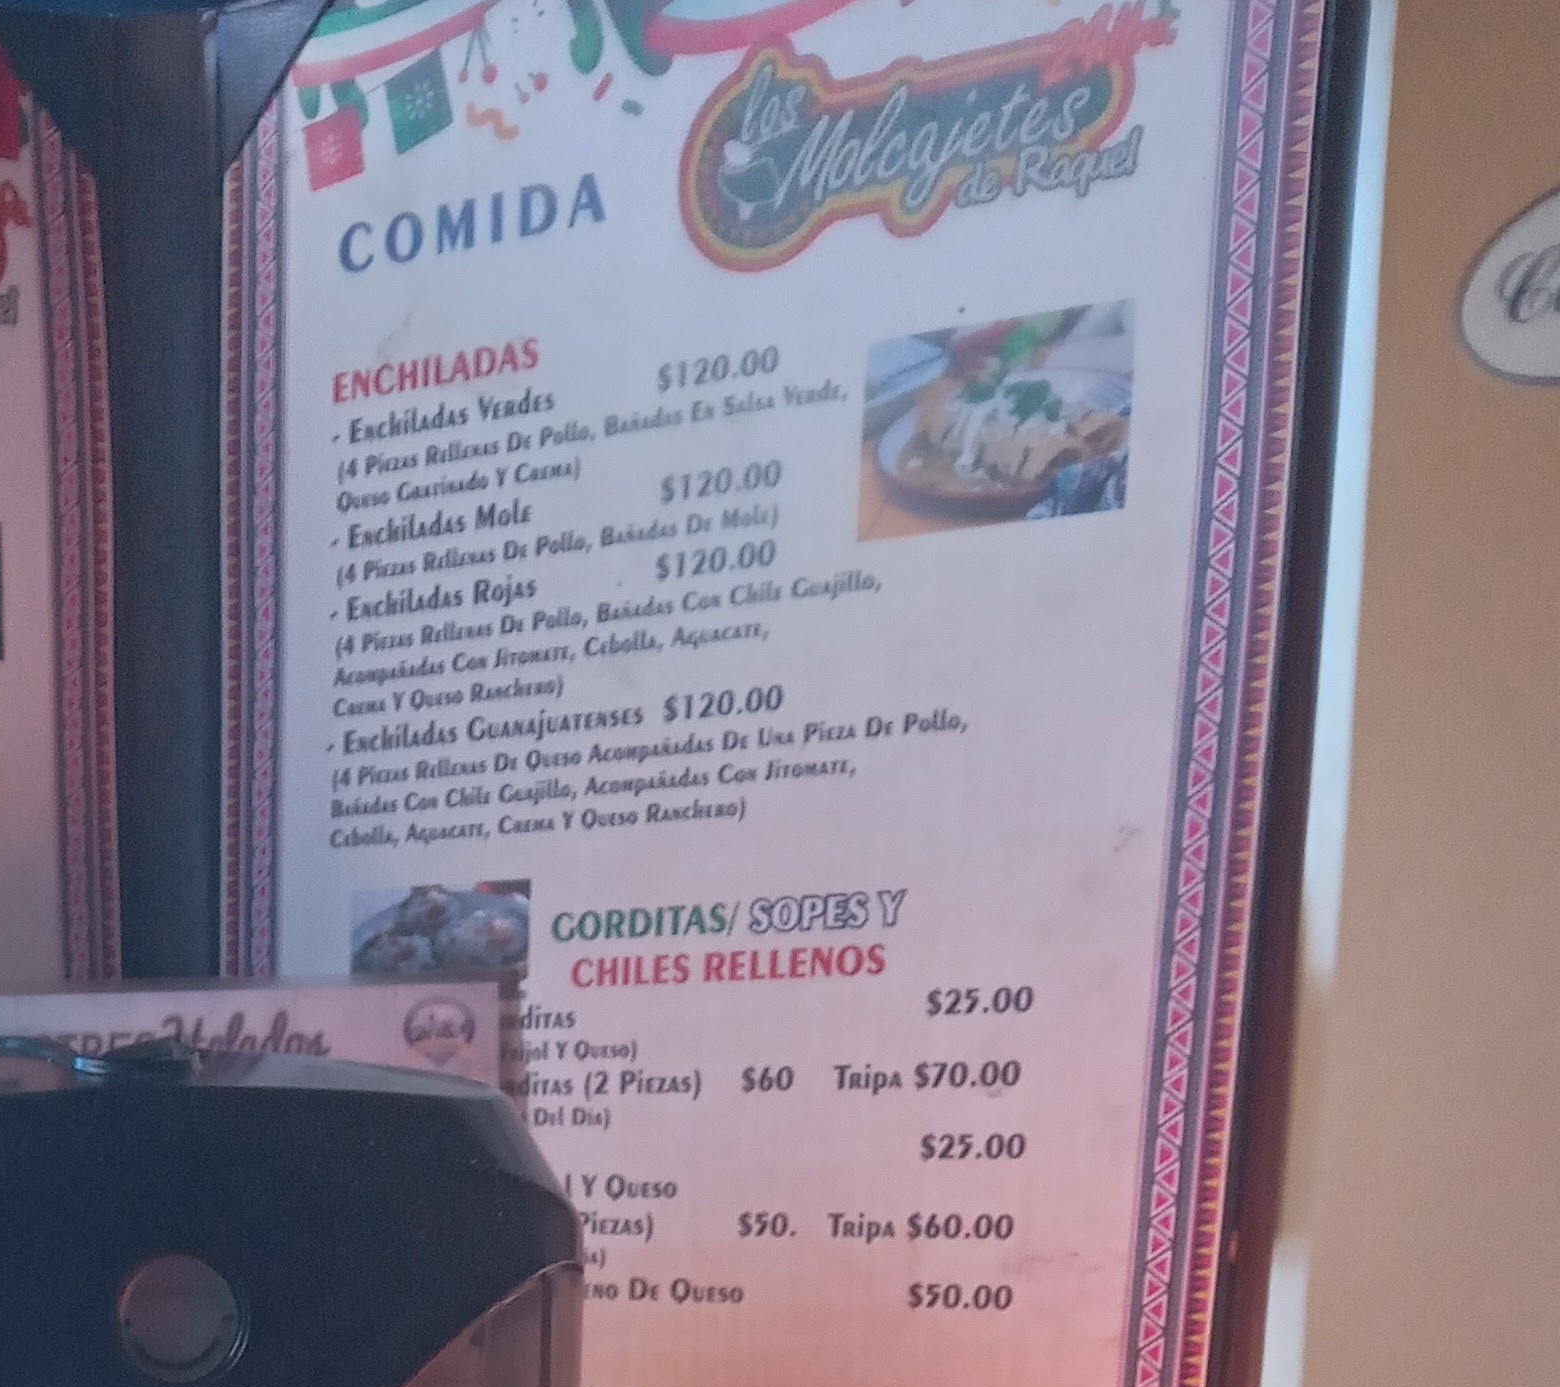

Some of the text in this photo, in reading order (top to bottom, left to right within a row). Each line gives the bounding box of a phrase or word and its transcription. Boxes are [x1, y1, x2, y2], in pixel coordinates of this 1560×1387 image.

[775, 84, 1092, 212] Molcajetes
[955, 124, 1144, 208] de Raquel
[338, 173, 605, 273] COMIDA
[333, 338, 538, 404] ENCHILADAS
[658, 345, 779, 394] $120.00
[661, 459, 782, 506] $120.00
[656, 539, 776, 583] $120.00
[664, 684, 784, 724] $120.00
[748, 891, 869, 935] SOPES
[877, 888, 906, 928] Y
[571, 943, 885, 989] CHILES RELLENOS
[927, 985, 1034, 1017] $25.00
[742, 1065, 795, 1094] $60
[914, 1060, 1021, 1090] $70.00
[921, 1133, 1027, 1161] $25.00
[907, 1212, 1014, 1242] $60.00
[908, 1282, 1013, 1311] $50.00
